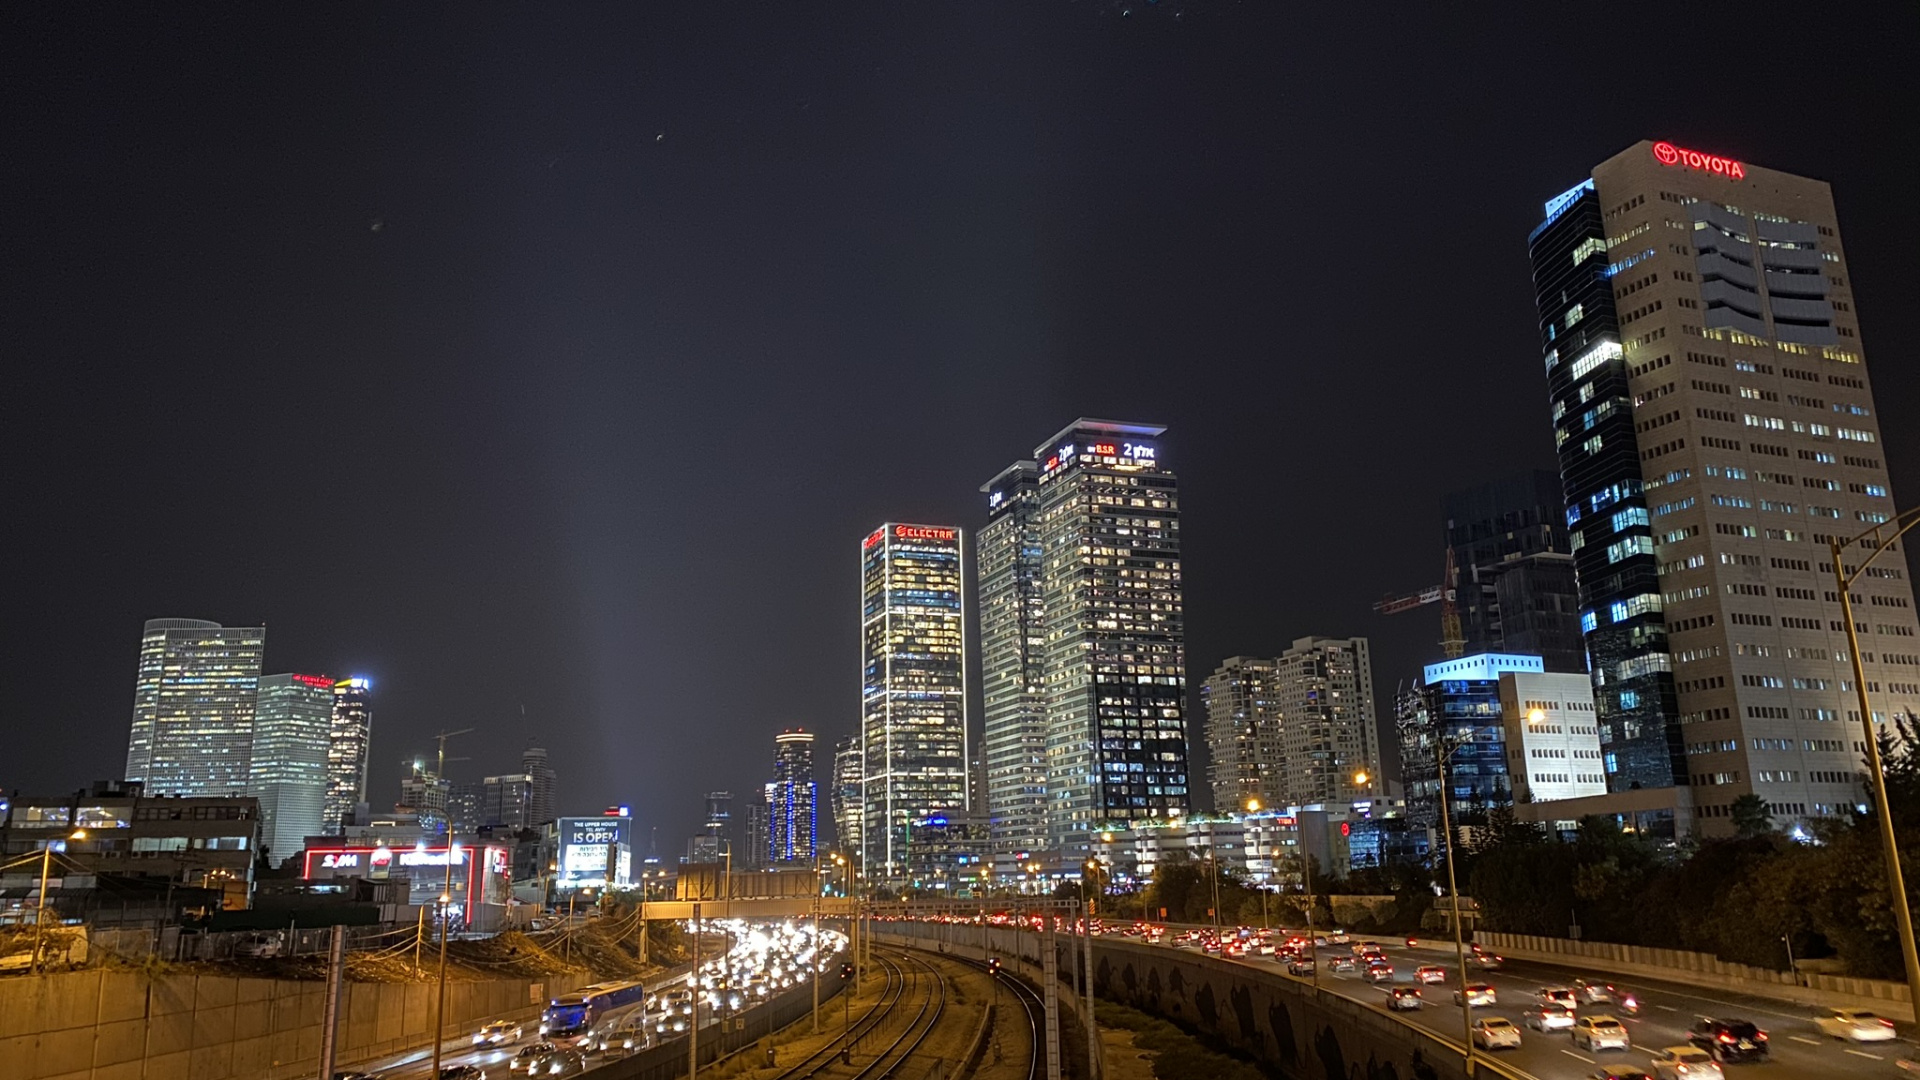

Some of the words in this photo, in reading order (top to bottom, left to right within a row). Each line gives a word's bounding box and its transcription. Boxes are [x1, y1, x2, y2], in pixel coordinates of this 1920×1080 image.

[1678, 149, 1744, 178] TOYOTA
[1124, 443, 1132, 456] 2
[907, 528, 953, 539] ELECTRA
[573, 833, 583, 843] IS
[585, 832, 618, 843] OPEN
[322, 855, 357, 868] SYM
